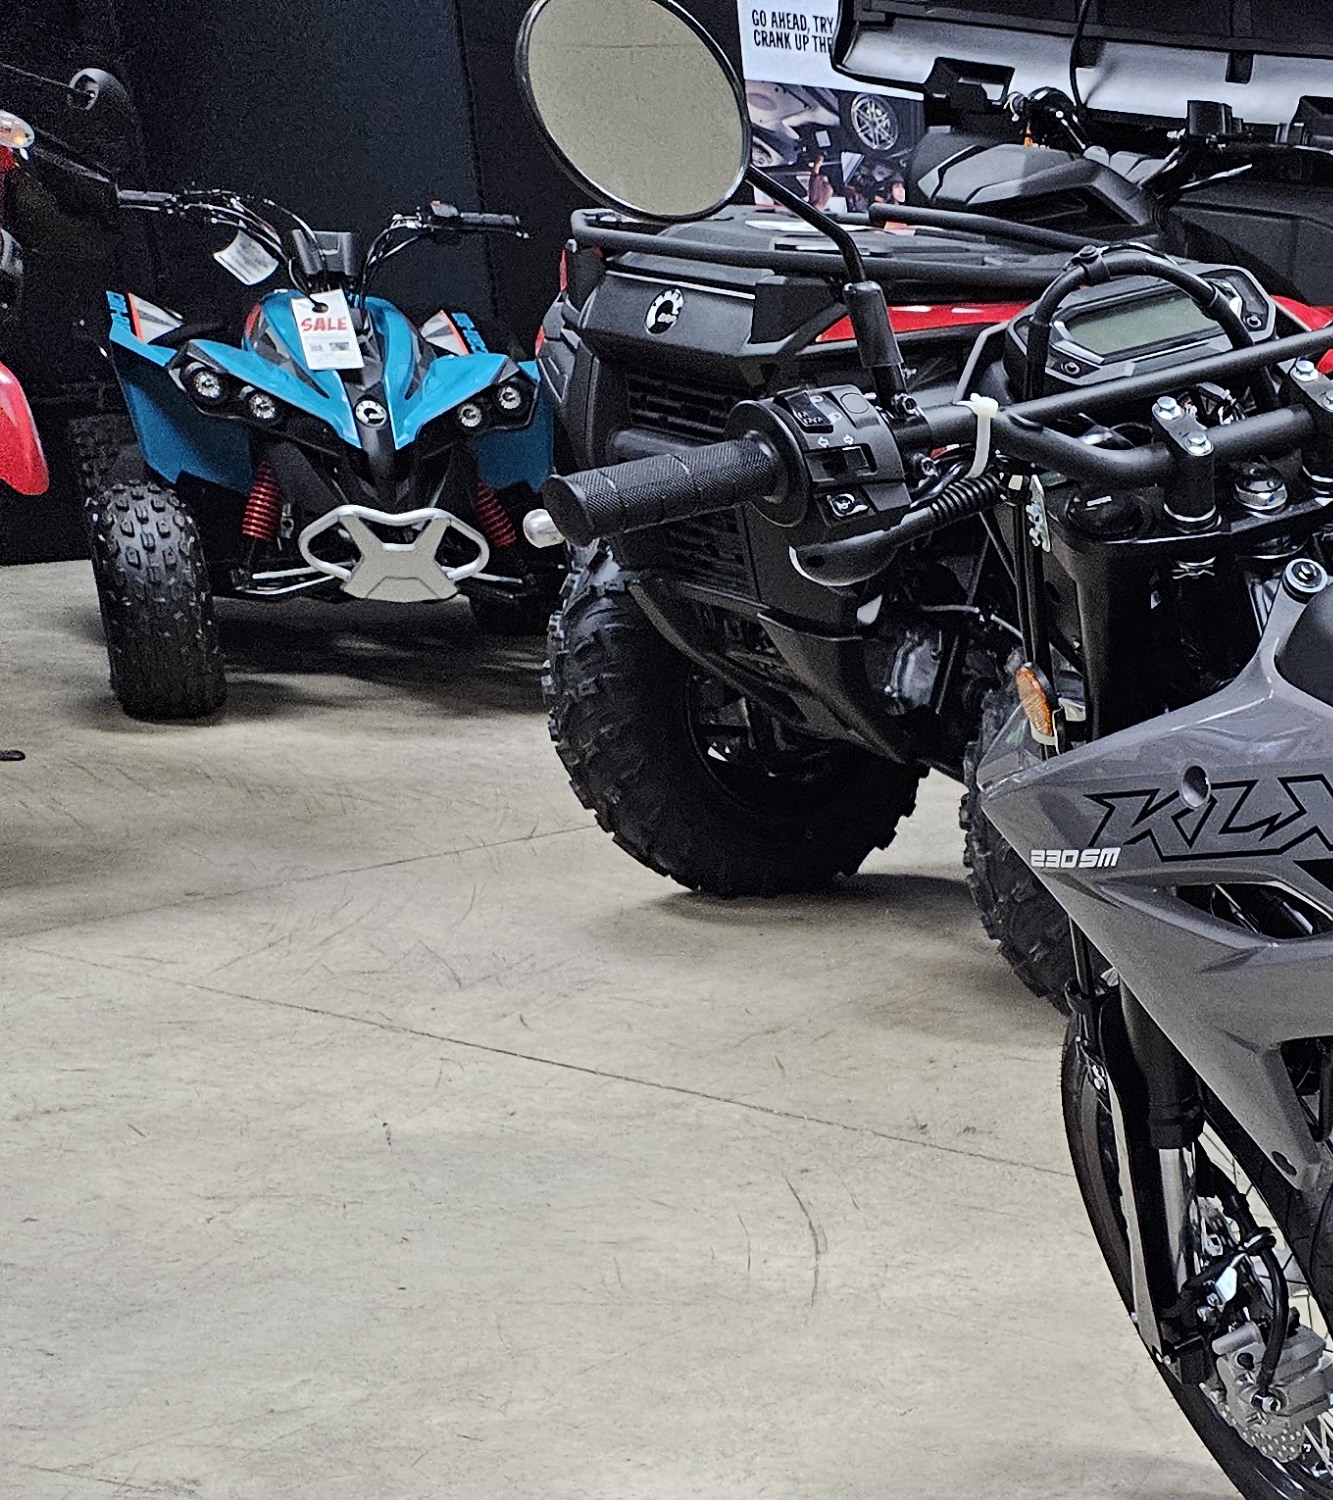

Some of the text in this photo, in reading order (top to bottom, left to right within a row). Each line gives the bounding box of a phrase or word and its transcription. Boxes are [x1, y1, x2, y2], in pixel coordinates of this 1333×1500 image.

[752, 9, 834, 34] GO AHEAD, TRY
[754, 29, 791, 49] CRANK
[794, 34, 809, 51] UP
[301, 317, 347, 332] SALE
